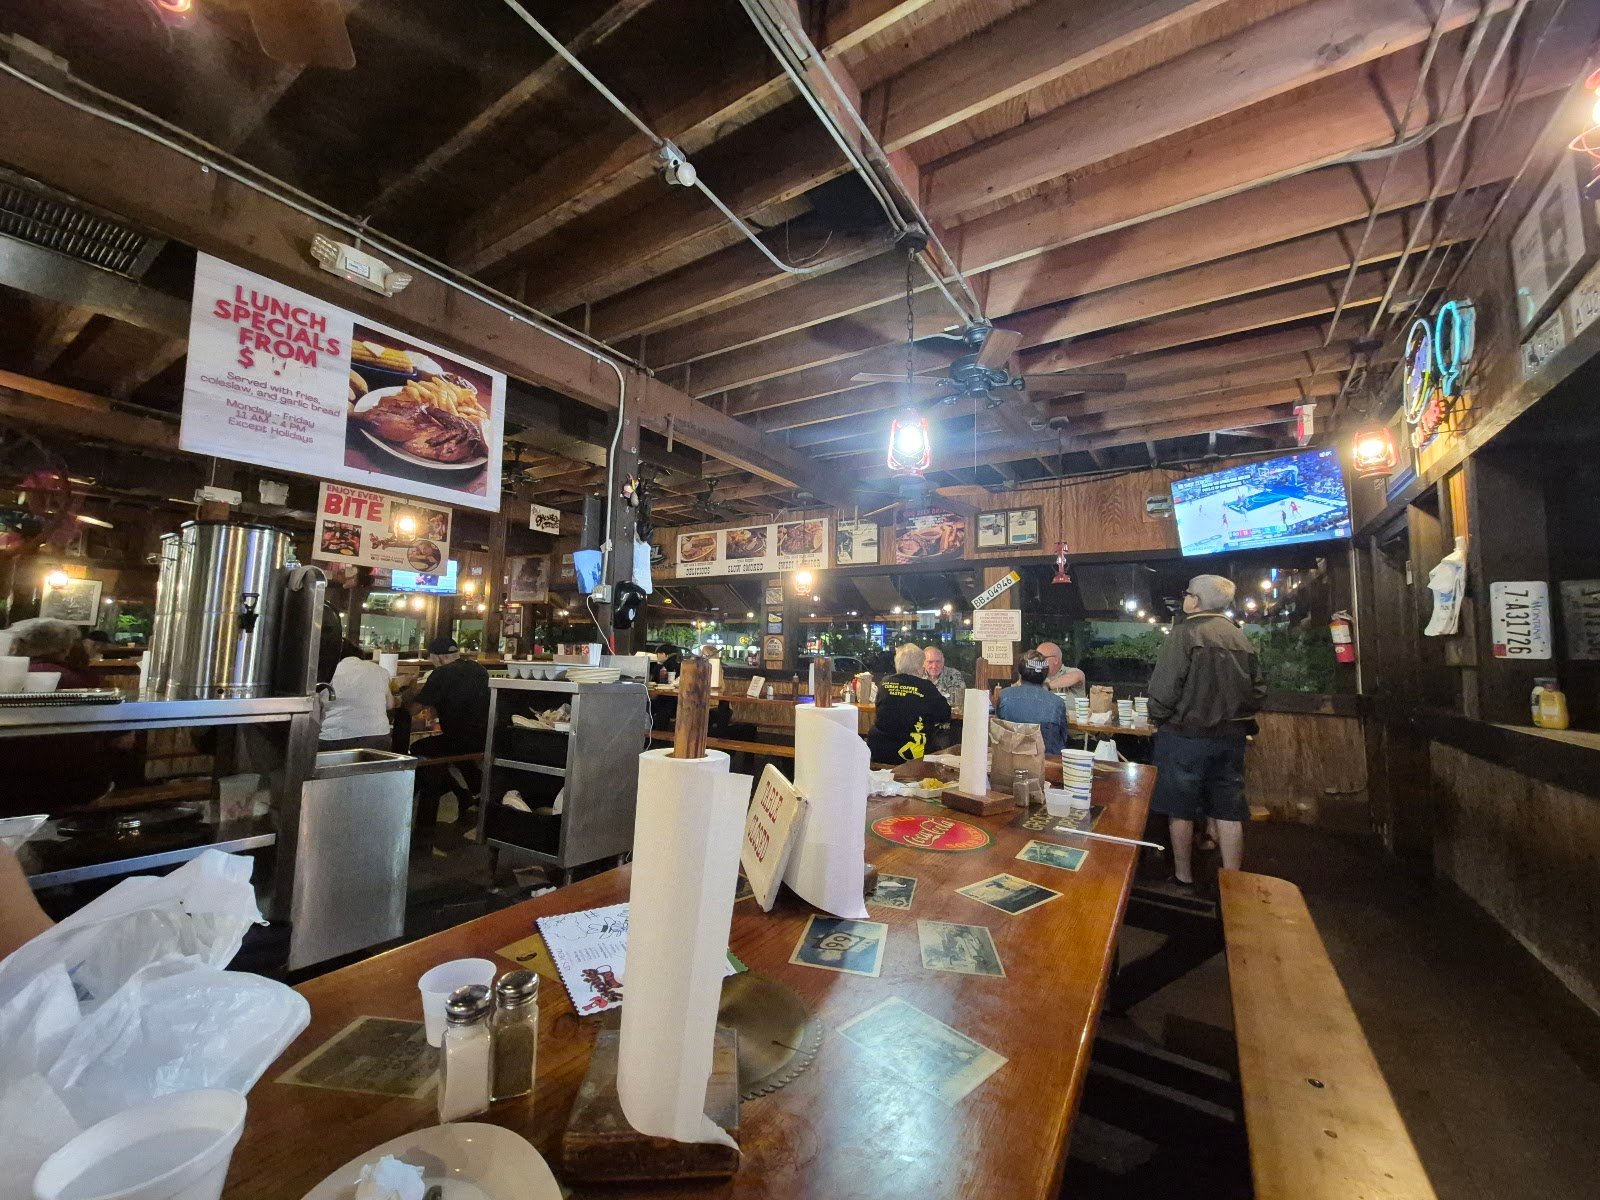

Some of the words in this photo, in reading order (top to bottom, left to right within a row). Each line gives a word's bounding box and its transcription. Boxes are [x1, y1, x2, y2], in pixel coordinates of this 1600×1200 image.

[235, 285, 326, 333] LUNCH
[213, 299, 340, 356] SPECIALS
[239, 326, 317, 368] FROM
[200, 375, 253, 396] coleslaw,
[257, 390, 277, 401] and
[280, 393, 309, 409] garlic
[311, 404, 340, 417] bread
[227, 371, 267, 389] Served
[270, 383, 293, 396] with
[296, 390, 321, 404] fries,
[226, 398, 272, 418] Monday
[283, 412, 315, 429] Friday
[228, 416, 267, 433] Except
[270, 426, 314, 444] Holidays
[235, 410, 247, 419] 11
[250, 413, 269, 423] AM
[290, 423, 307, 433] PM
[324, 492, 385, 523] BITE
[326, 484, 356, 497] ENJOY
[358, 491, 385, 502] EVERY
[1531, 600, 1543, 641] MONTANA
